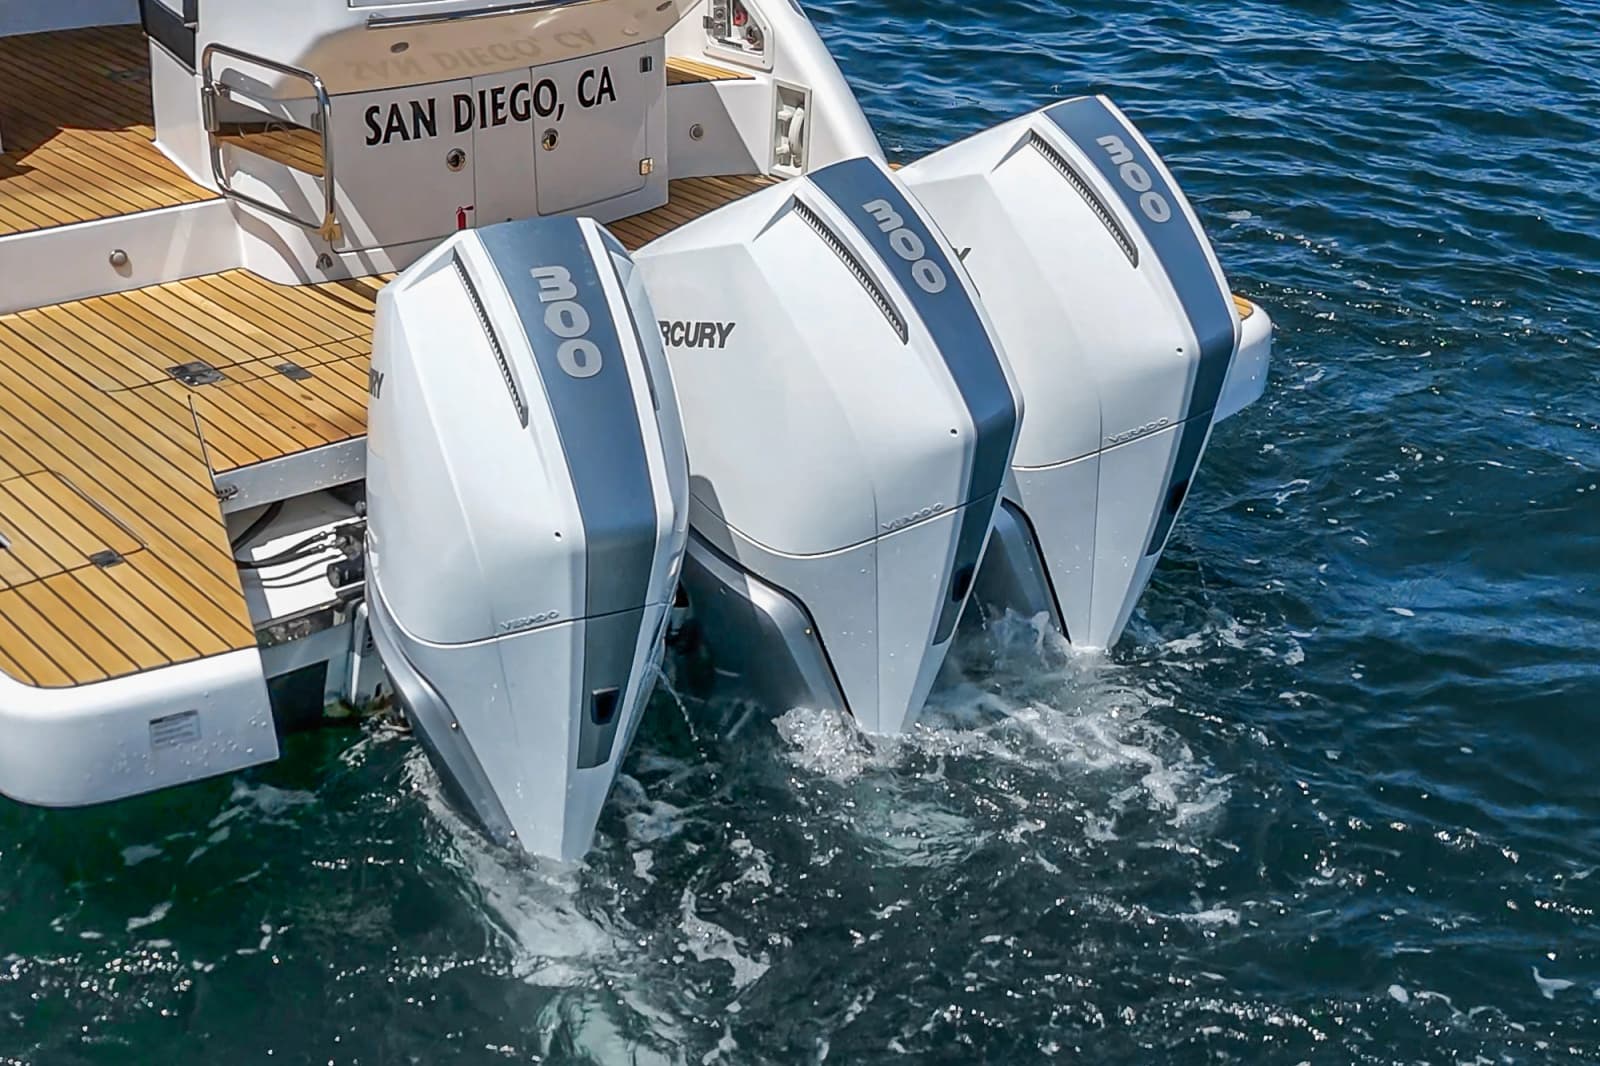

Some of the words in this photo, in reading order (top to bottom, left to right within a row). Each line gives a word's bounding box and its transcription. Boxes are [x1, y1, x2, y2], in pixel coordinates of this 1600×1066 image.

[364, 97, 437, 147] SAN
[453, 78, 565, 134] DIEGO,
[576, 65, 617, 109] CA
[1096, 134, 1172, 223] 300
[861, 198, 947, 294] 300
[529, 265, 604, 379] 300
[658, 319, 736, 349] RCURY
